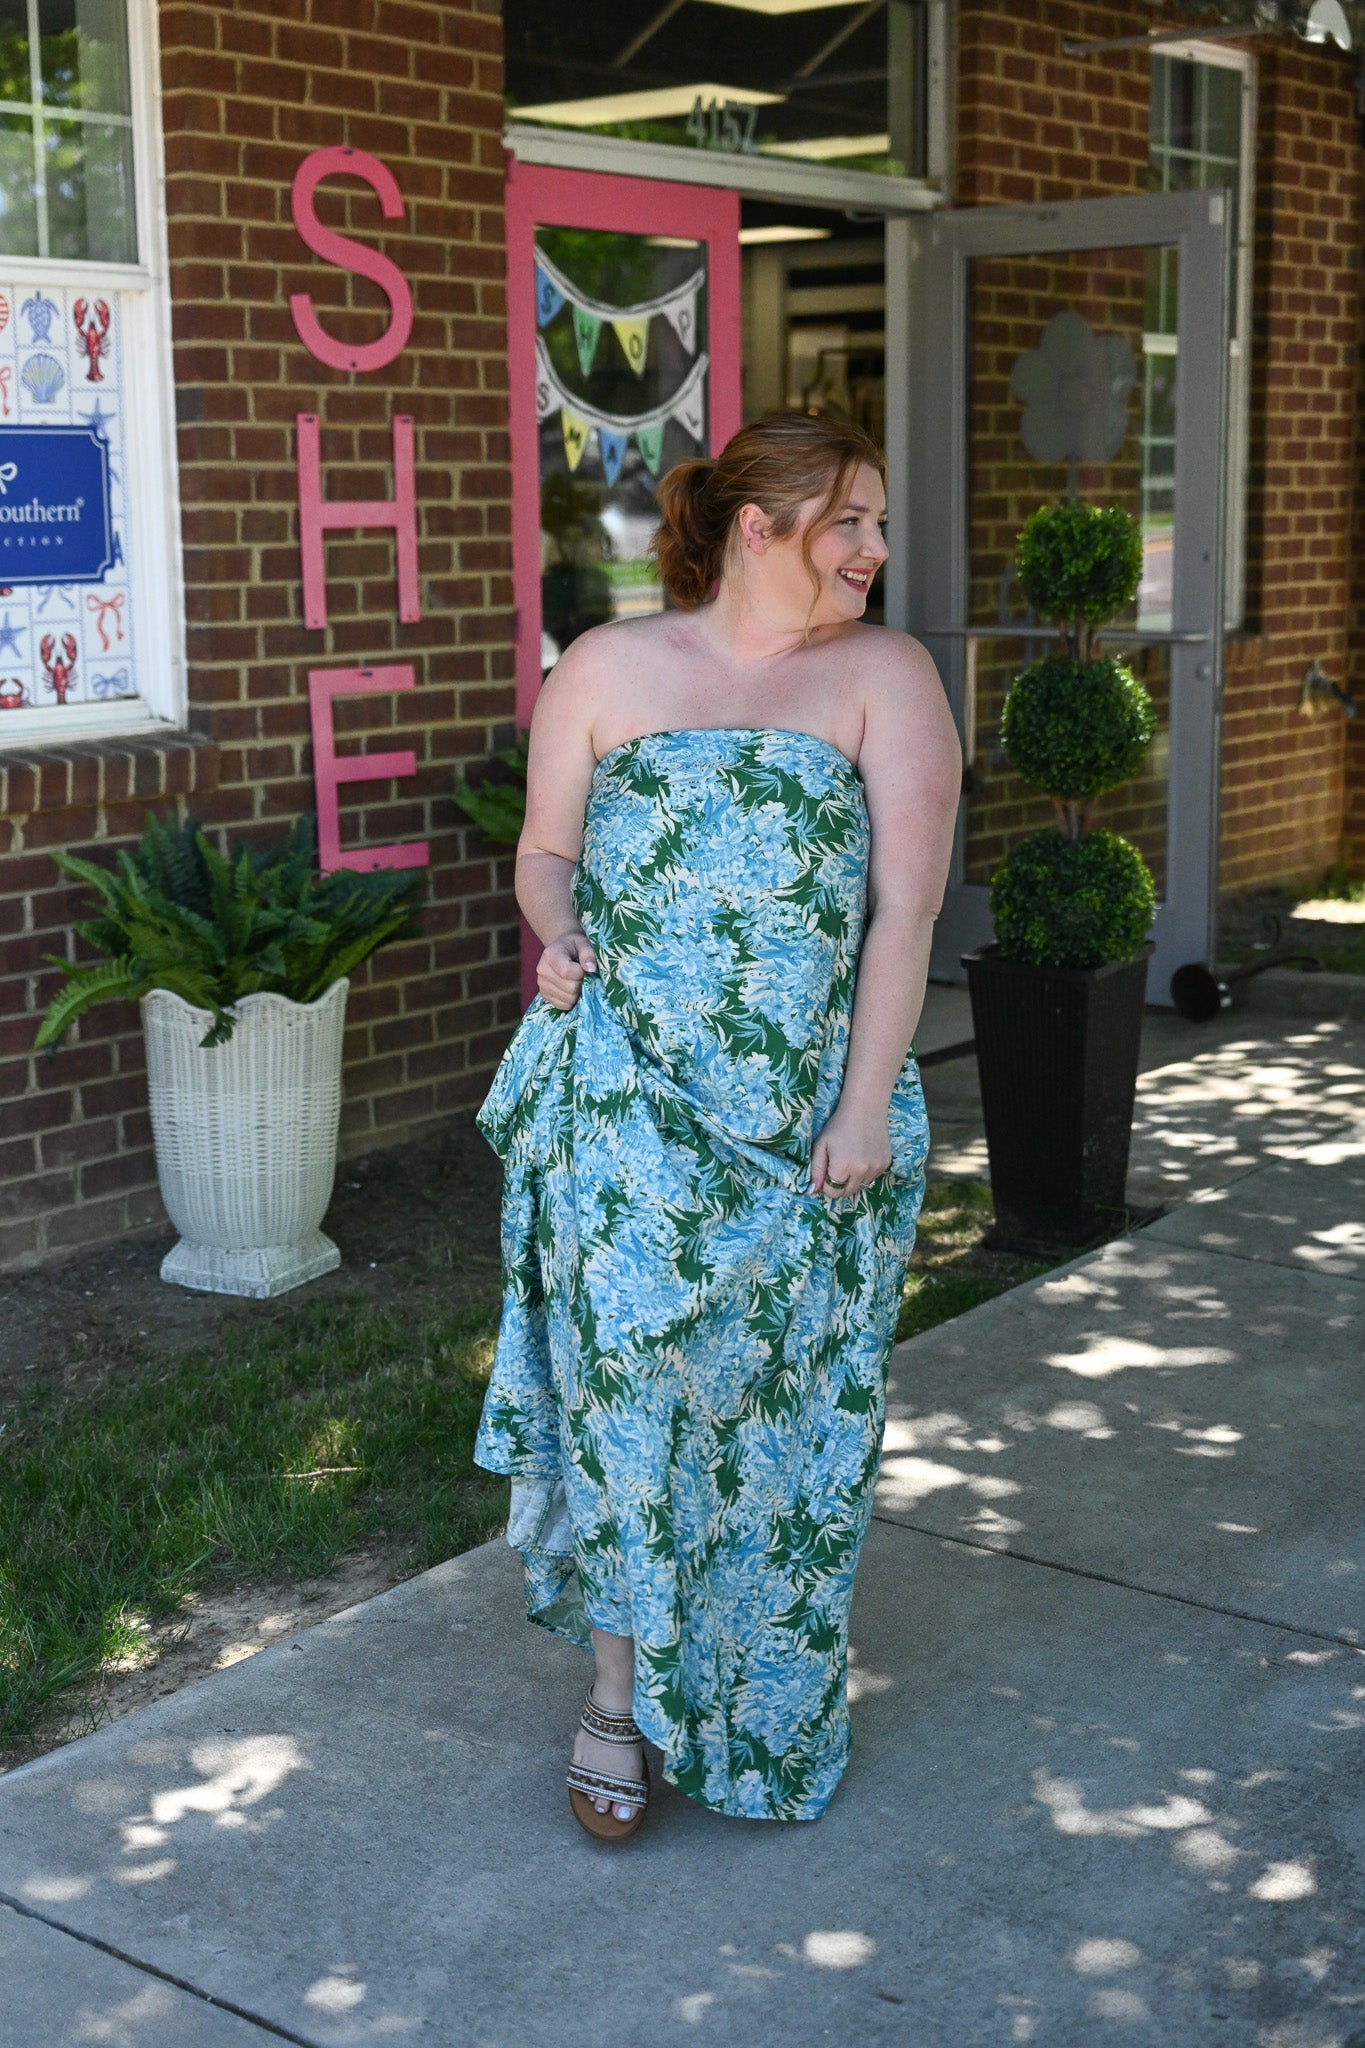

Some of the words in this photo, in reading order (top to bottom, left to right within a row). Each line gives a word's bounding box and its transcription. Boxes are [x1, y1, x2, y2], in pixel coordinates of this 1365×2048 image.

[686, 94, 759, 154] 4157
[540, 282, 692, 360] SHOP
[537, 381, 699, 464] SMALL
[290, 145, 430, 880] SHE
